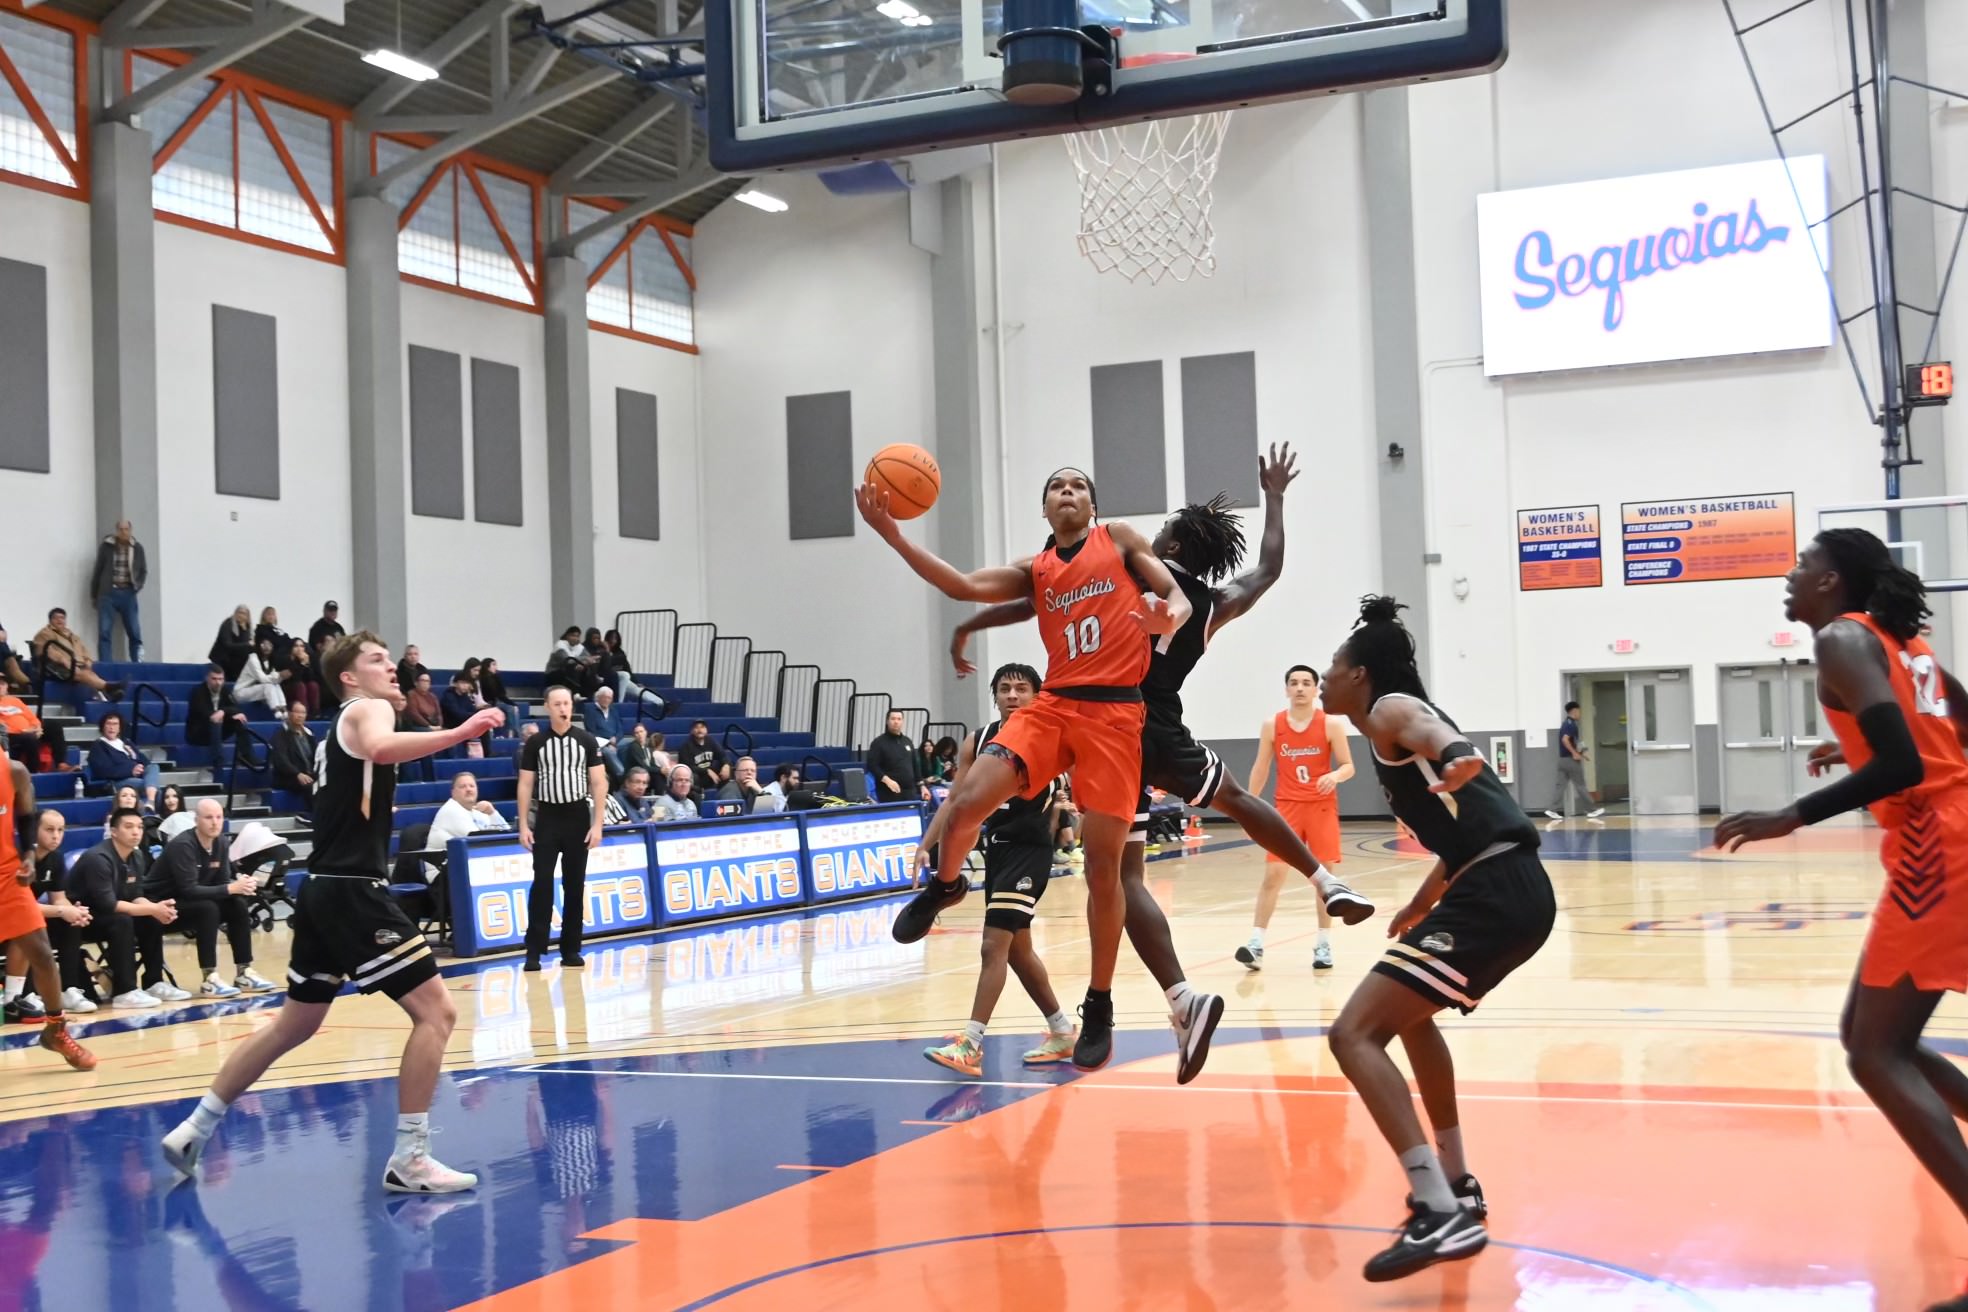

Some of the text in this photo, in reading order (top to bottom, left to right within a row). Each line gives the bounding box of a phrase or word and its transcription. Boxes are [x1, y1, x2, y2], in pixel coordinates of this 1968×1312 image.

[1514, 197, 1790, 331] Sequoias
[1528, 511, 1585, 524] WOMEN'S
[1638, 499, 1778, 517] WOMEN'S BASKETBALL
[1522, 524, 1595, 537] BASKETBALL
[1045, 577, 1115, 615] Sequoias
[1064, 615, 1100, 661] 10
[1296, 765, 1310, 784] 0
[676, 833, 783, 859] HOME OF THE
[812, 843, 922, 893] GIANTS
[664, 858, 799, 914] GIANTS
